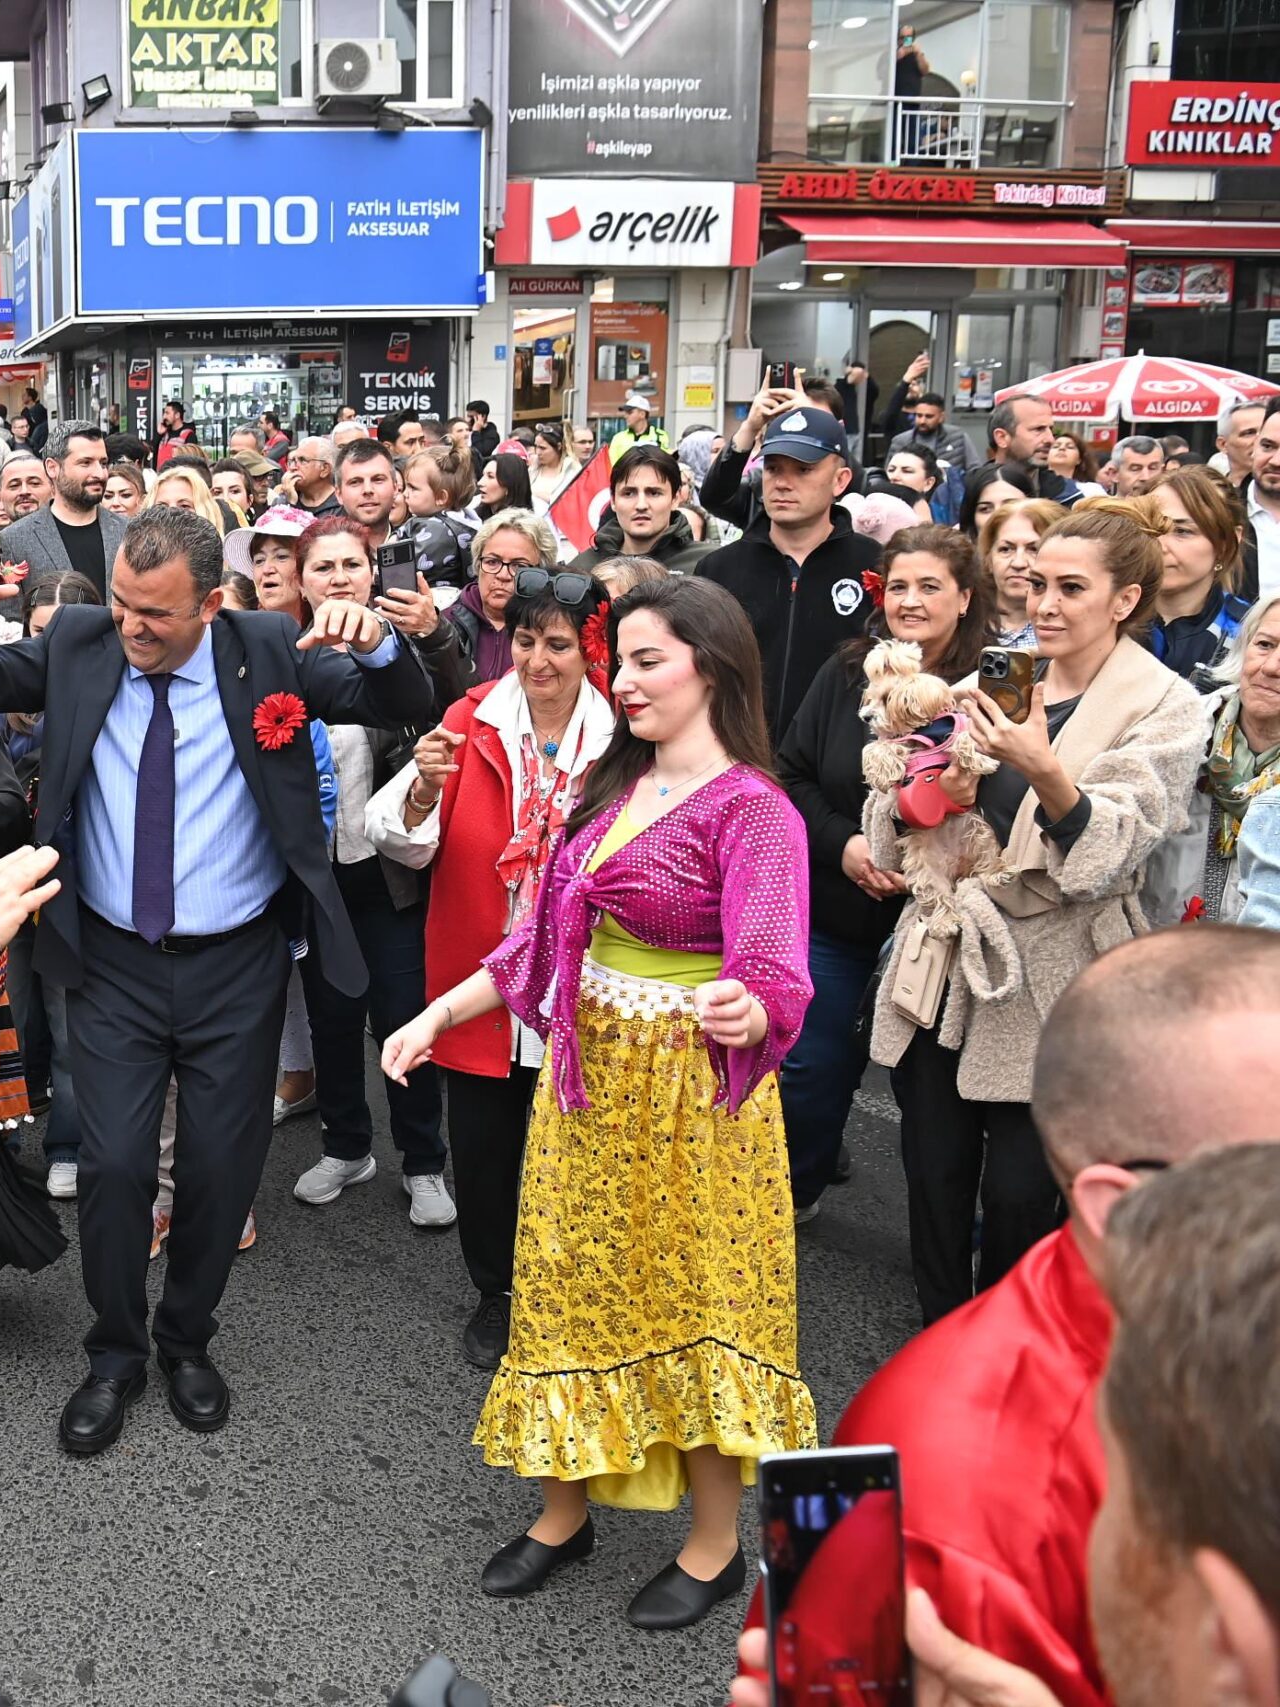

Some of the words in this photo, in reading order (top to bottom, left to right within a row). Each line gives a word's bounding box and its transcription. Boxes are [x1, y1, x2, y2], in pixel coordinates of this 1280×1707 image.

[130, 32, 278, 66] AKTAR
[540, 73, 595, 92] İşimizi
[597, 74, 640, 92] aşkla
[643, 78, 702, 92] yapıyor
[508, 104, 585, 123] yenilikleri
[588, 104, 631, 122] aşkla
[633, 104, 732, 123] tasarlıyoruz.
[586, 140, 653, 158] #aşkileyap
[1149, 130, 1273, 154] KINIKLAR
[777, 169, 858, 199] ABDİ
[993, 183, 1055, 207] Tekirdağ
[1055, 184, 1106, 205] Köftesi
[347, 198, 391, 217] FATİH
[397, 197, 460, 219] İLETİŞİM
[95, 195, 318, 247] TECNO
[347, 221, 430, 237] AKSESUAR
[589, 206, 719, 251] arçelik
[528, 279, 581, 293] GÜRKAN
[223, 326, 273, 341] İLETİŞİM
[276, 326, 339, 338] AKSESUAR
[359, 366, 436, 389] TEKNİK
[364, 391, 432, 411] SERVİS
